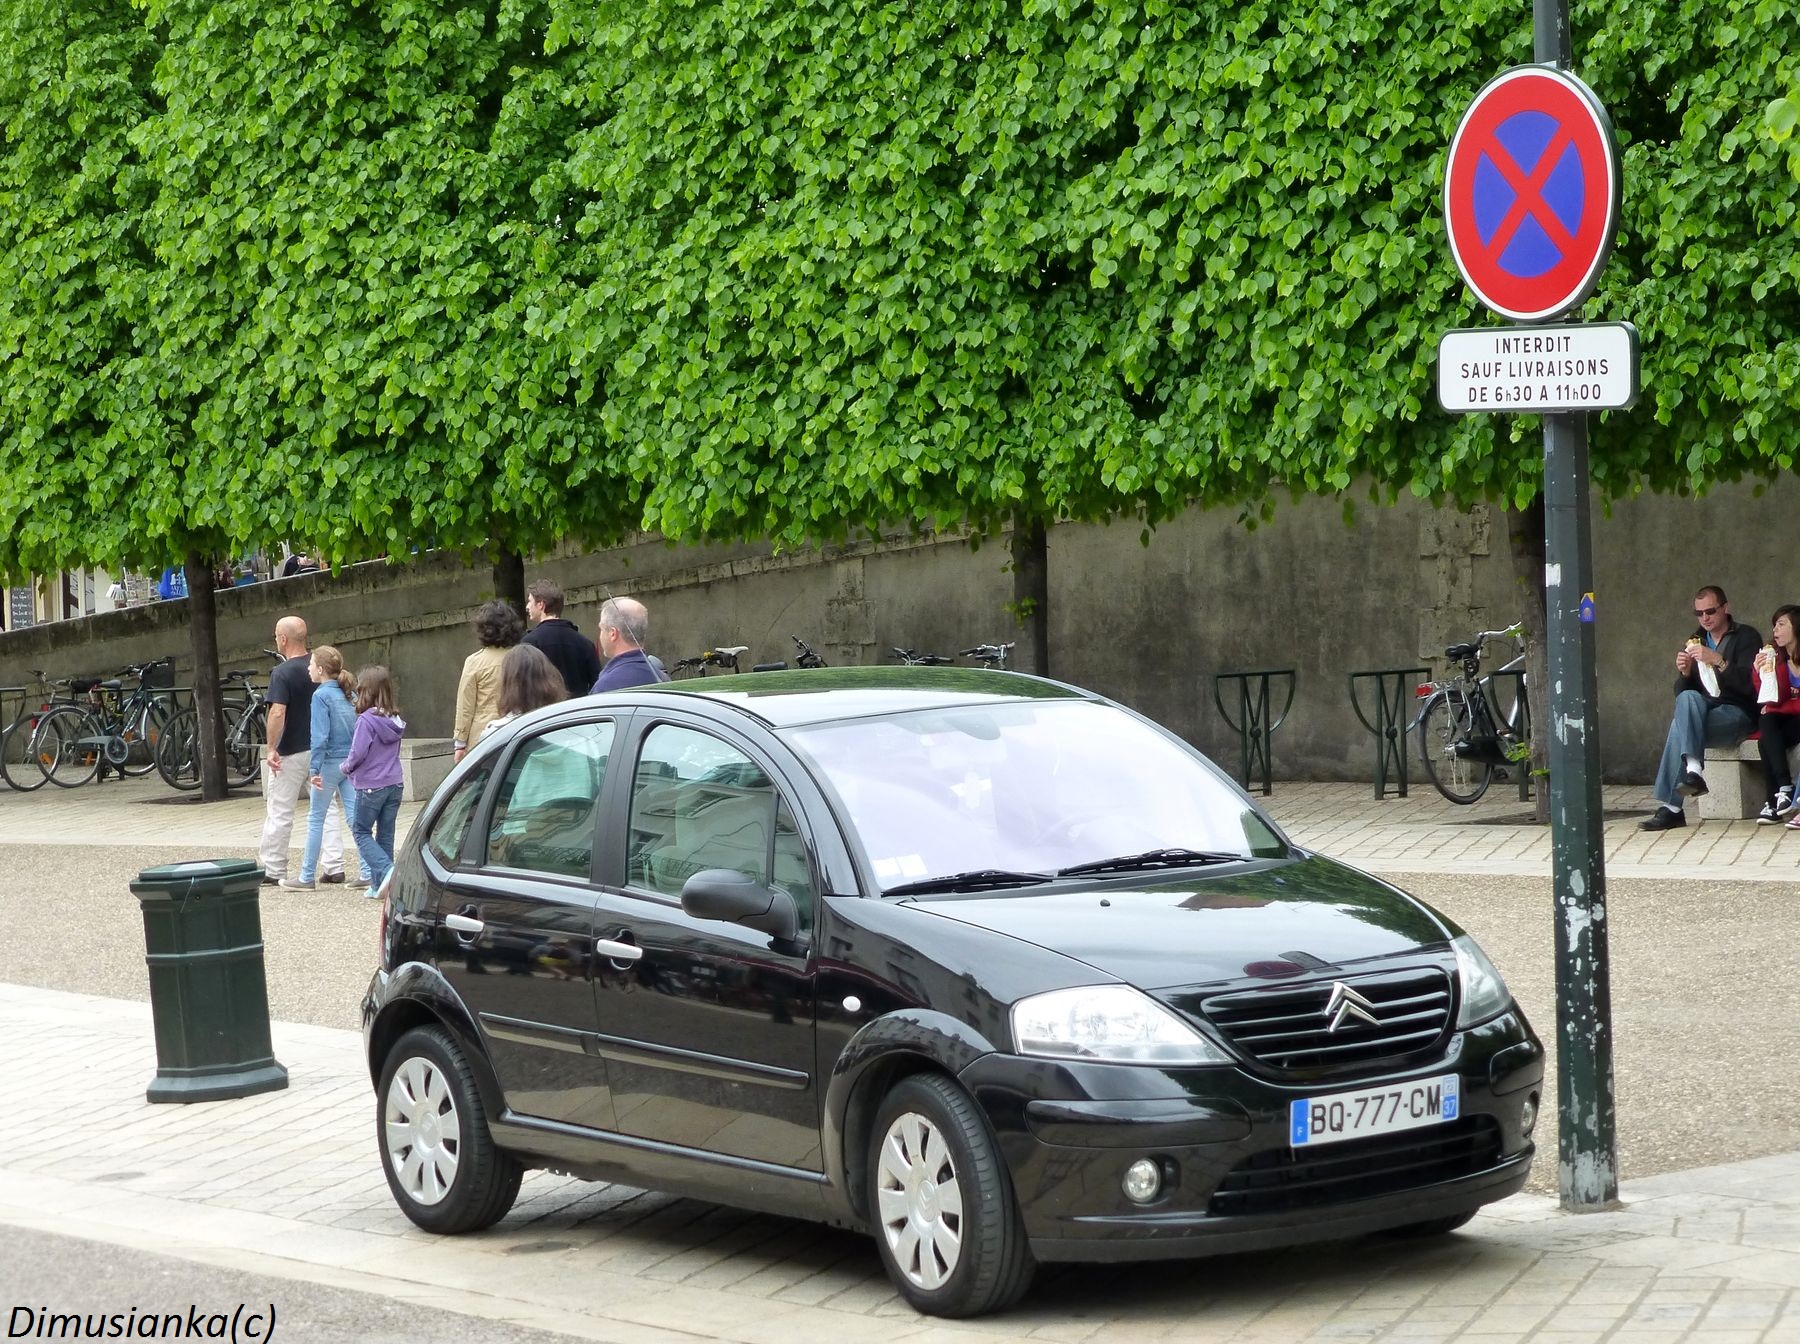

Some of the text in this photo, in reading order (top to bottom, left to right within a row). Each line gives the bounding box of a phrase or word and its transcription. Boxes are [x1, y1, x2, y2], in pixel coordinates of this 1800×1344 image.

[1496, 336, 1571, 354] INTERDIT
[1461, 359, 1609, 379] SAUF LIVRAISONS
[1468, 383, 1602, 403] DE 6h30 A 11h00
[1310, 1084, 1441, 1135] BQ-777-CM
[1443, 1100, 1456, 1116] 37
[1296, 1128, 1303, 1137] F
